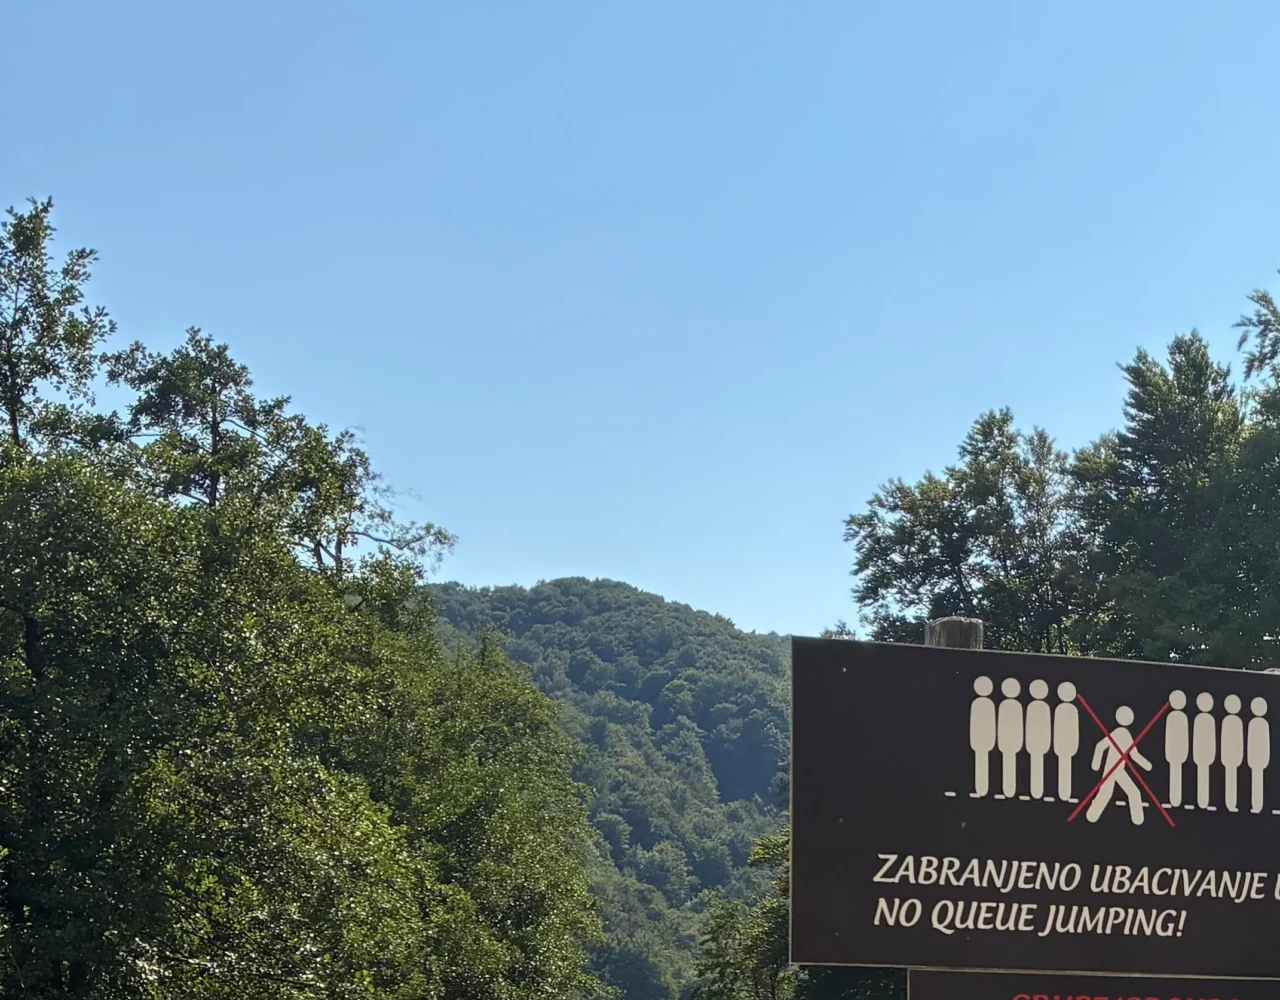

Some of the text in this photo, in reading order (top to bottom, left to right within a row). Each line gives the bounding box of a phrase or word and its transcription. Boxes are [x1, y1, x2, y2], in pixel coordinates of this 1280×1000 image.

[872, 853, 1082, 894] ZABRANJENO
[1090, 864, 1268, 904] UBACIVANJE
[873, 897, 1187, 937] NO QUEUE JUMPING!
